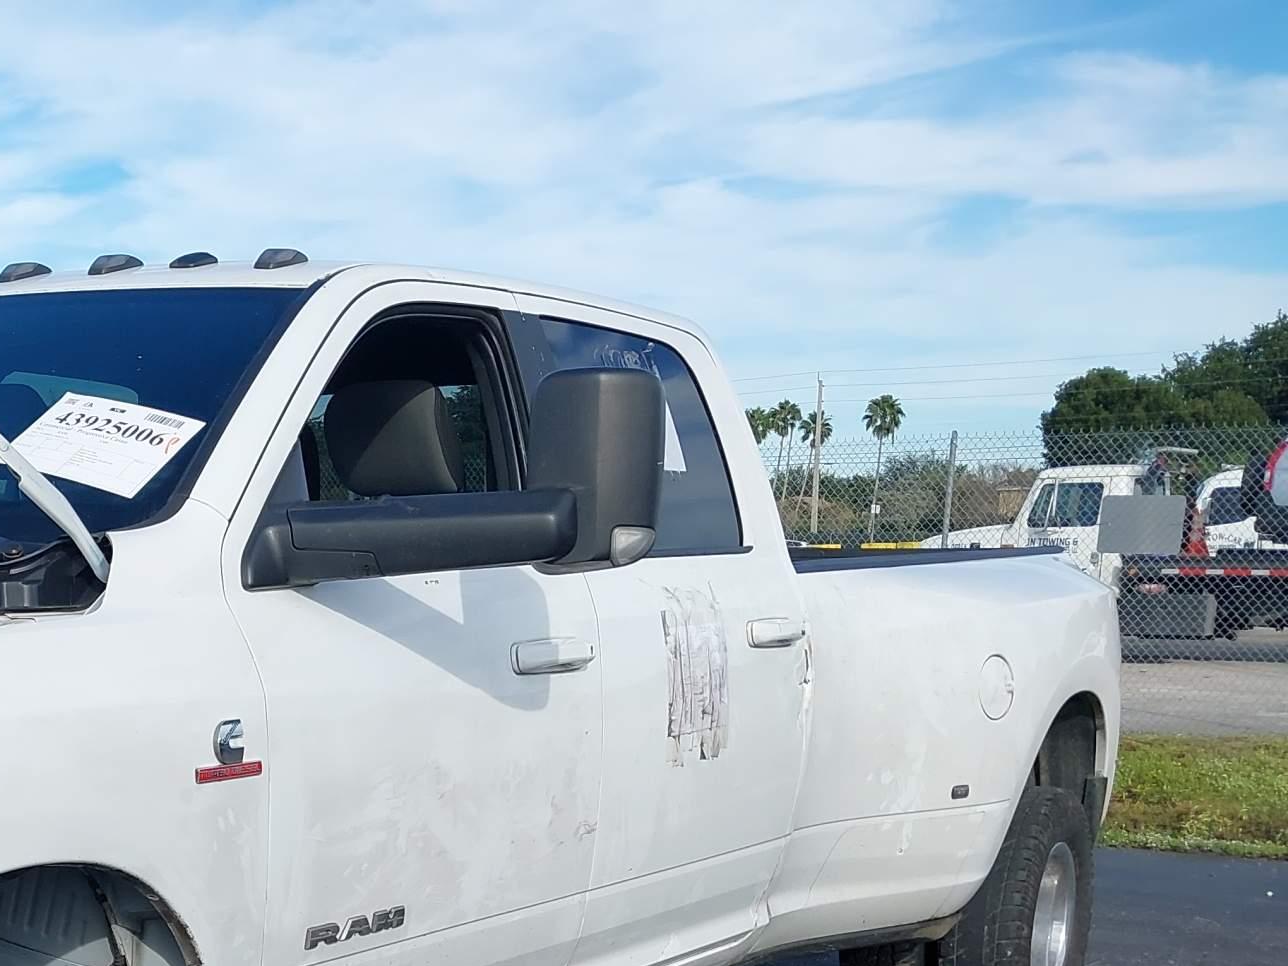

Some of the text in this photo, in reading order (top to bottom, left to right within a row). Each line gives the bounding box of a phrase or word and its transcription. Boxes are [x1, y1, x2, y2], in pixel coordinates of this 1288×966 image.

[55, 411, 165, 447] 43925006
[1039, 537, 1070, 546] TOWING
[304, 905, 405, 950] RAM
